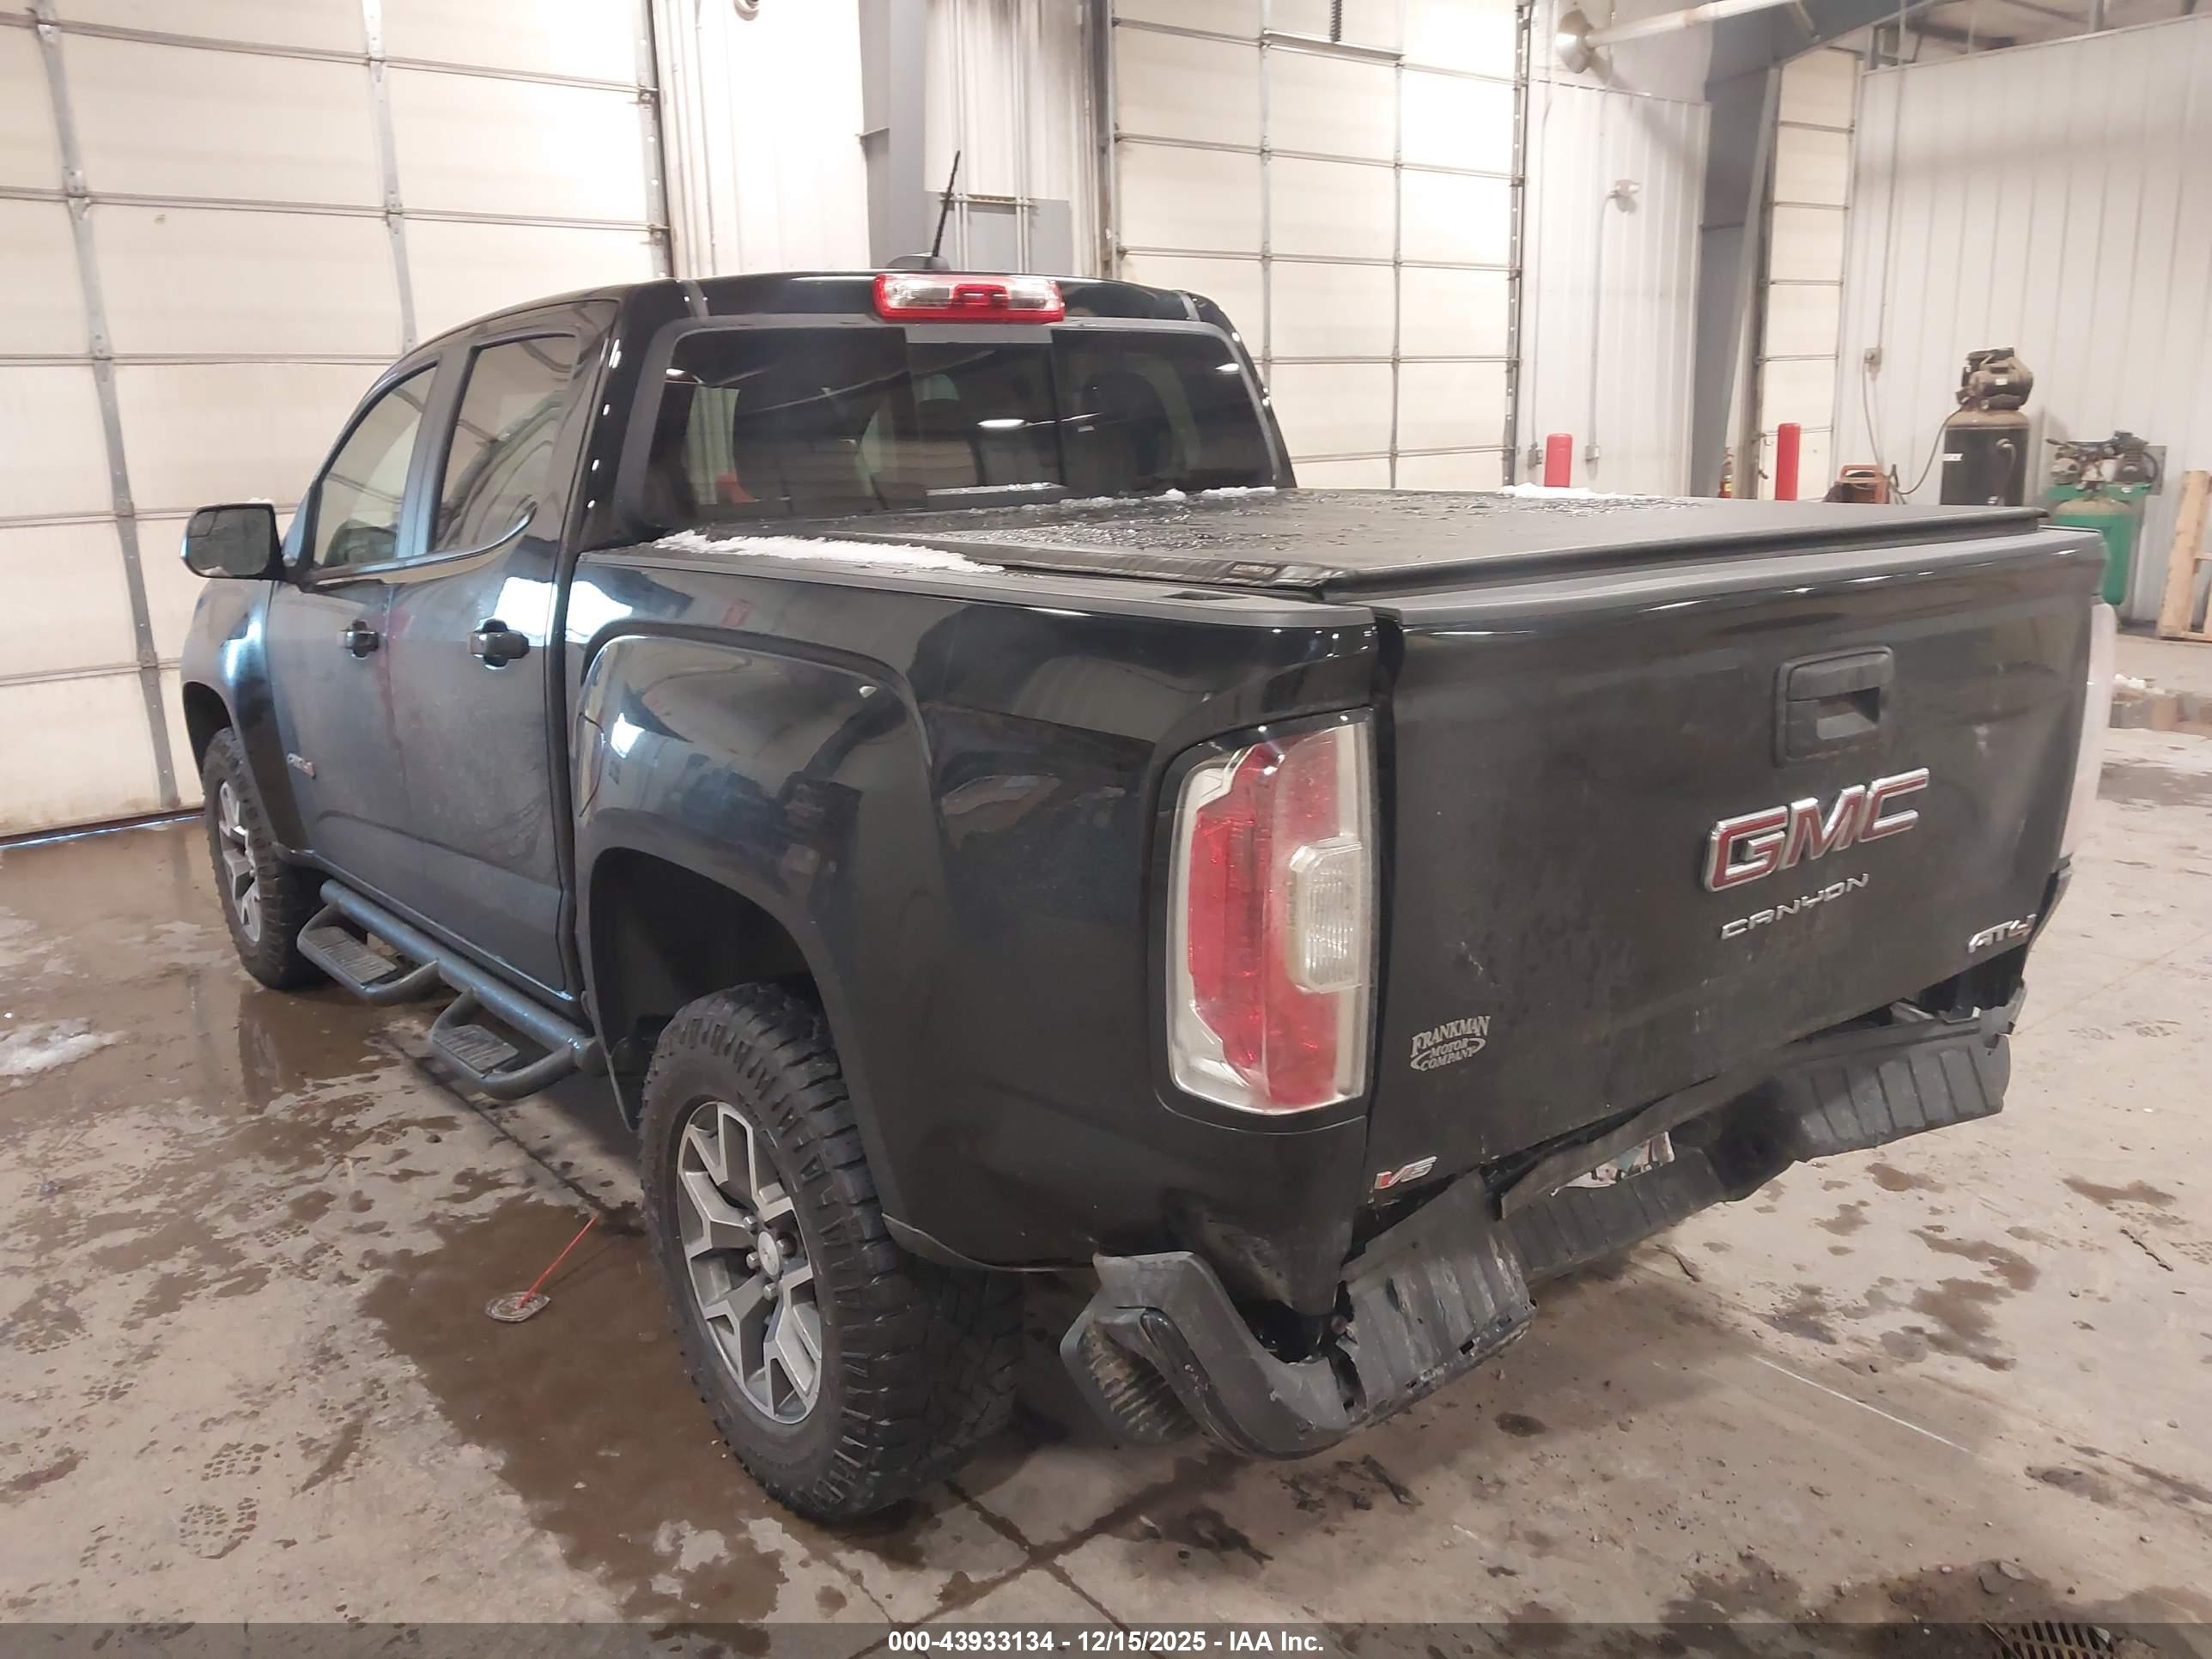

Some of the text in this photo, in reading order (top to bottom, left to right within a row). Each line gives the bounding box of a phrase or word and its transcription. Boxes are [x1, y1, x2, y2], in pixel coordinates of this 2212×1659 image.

[1705, 767, 1930, 893] GMC
[1720, 872, 1869, 940] CANYON
[1409, 1015, 1492, 1059] FRANKMAN
[1428, 1037, 1469, 1059] MOTOR
[1419, 1046, 1478, 1072] COMPANY
[1374, 1155, 1438, 1190] V6
